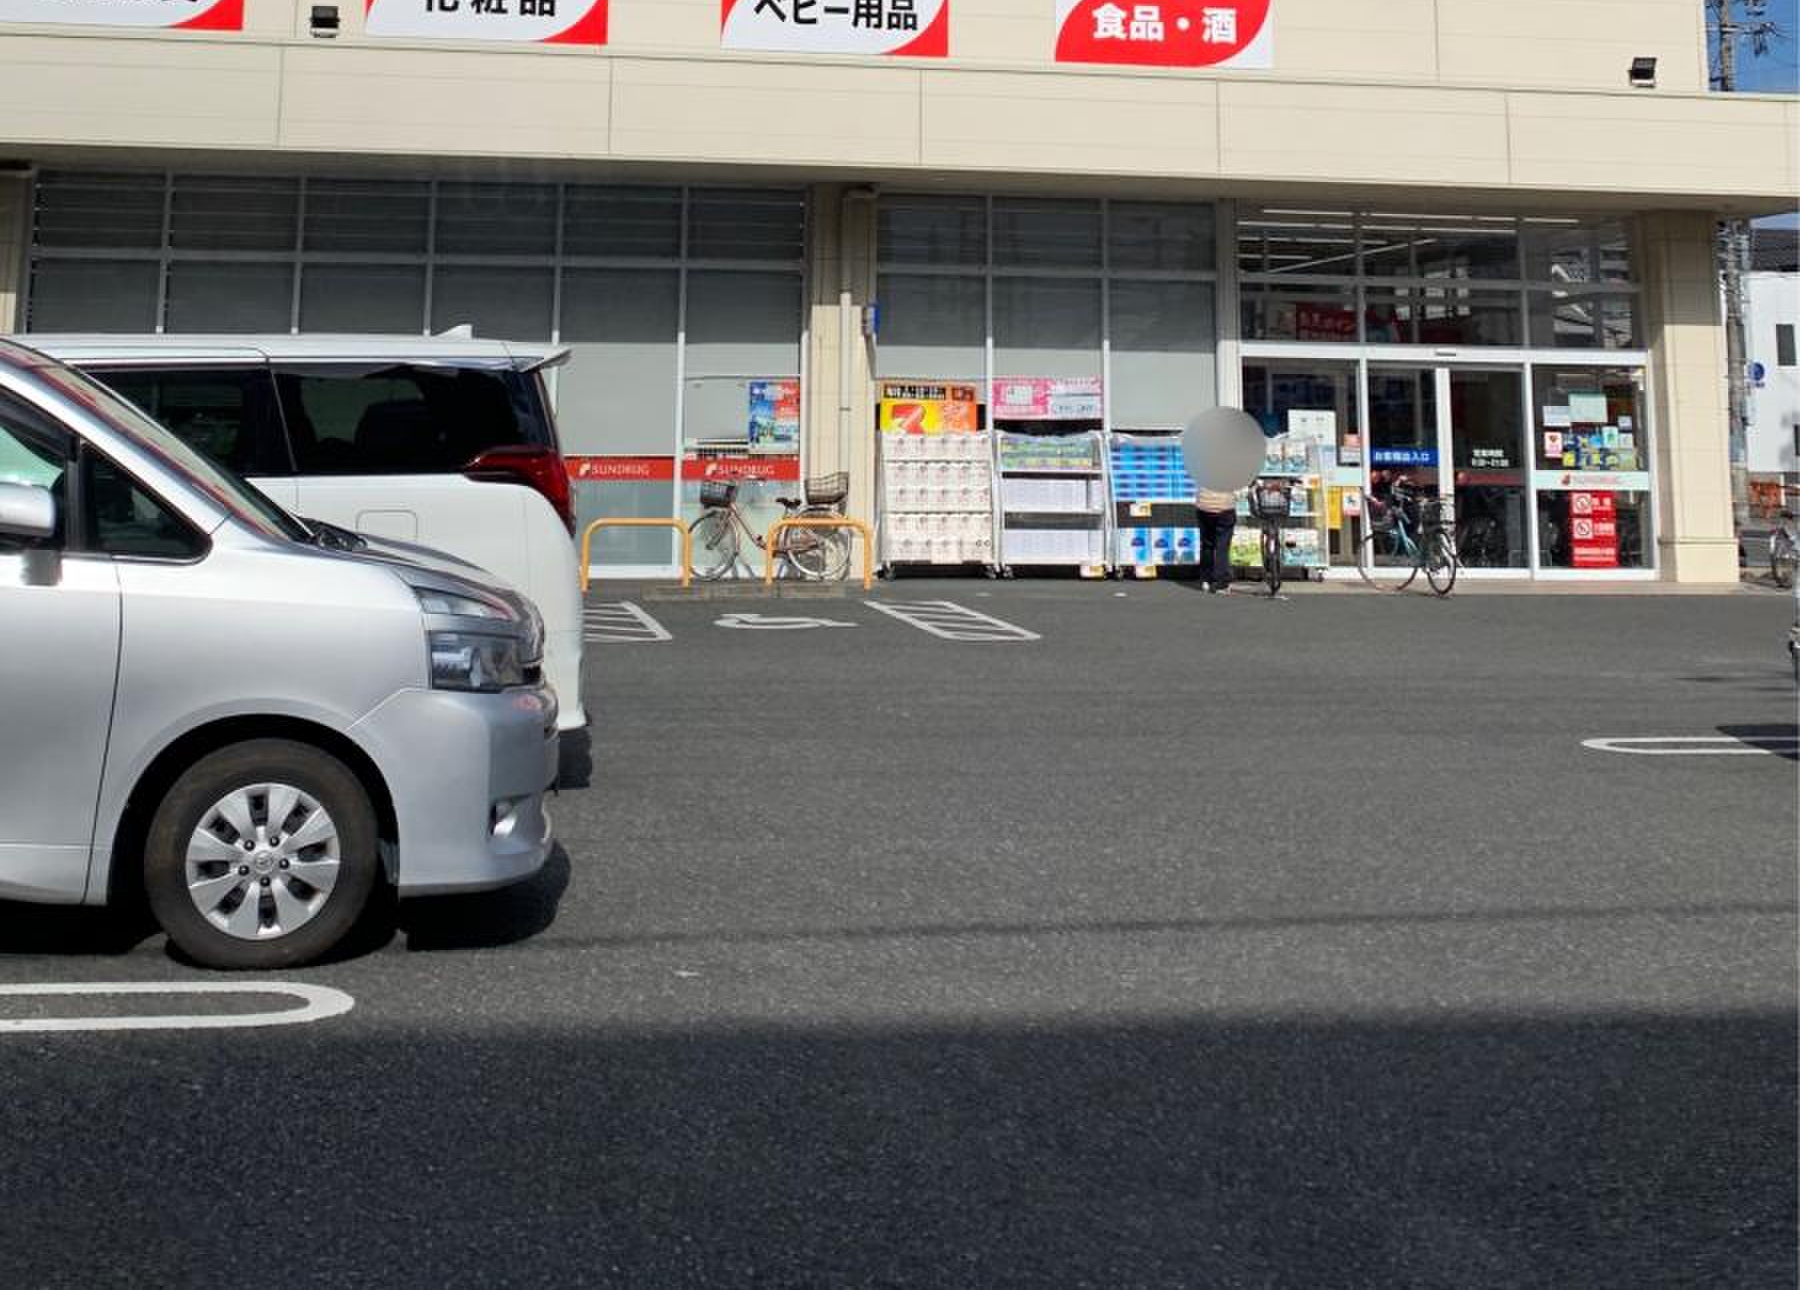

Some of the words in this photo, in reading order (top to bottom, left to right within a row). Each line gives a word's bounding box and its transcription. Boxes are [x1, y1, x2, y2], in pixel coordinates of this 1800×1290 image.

[1093, 4, 1237, 45] 食品・酒
[591, 463, 650, 476] SUNDRUG
